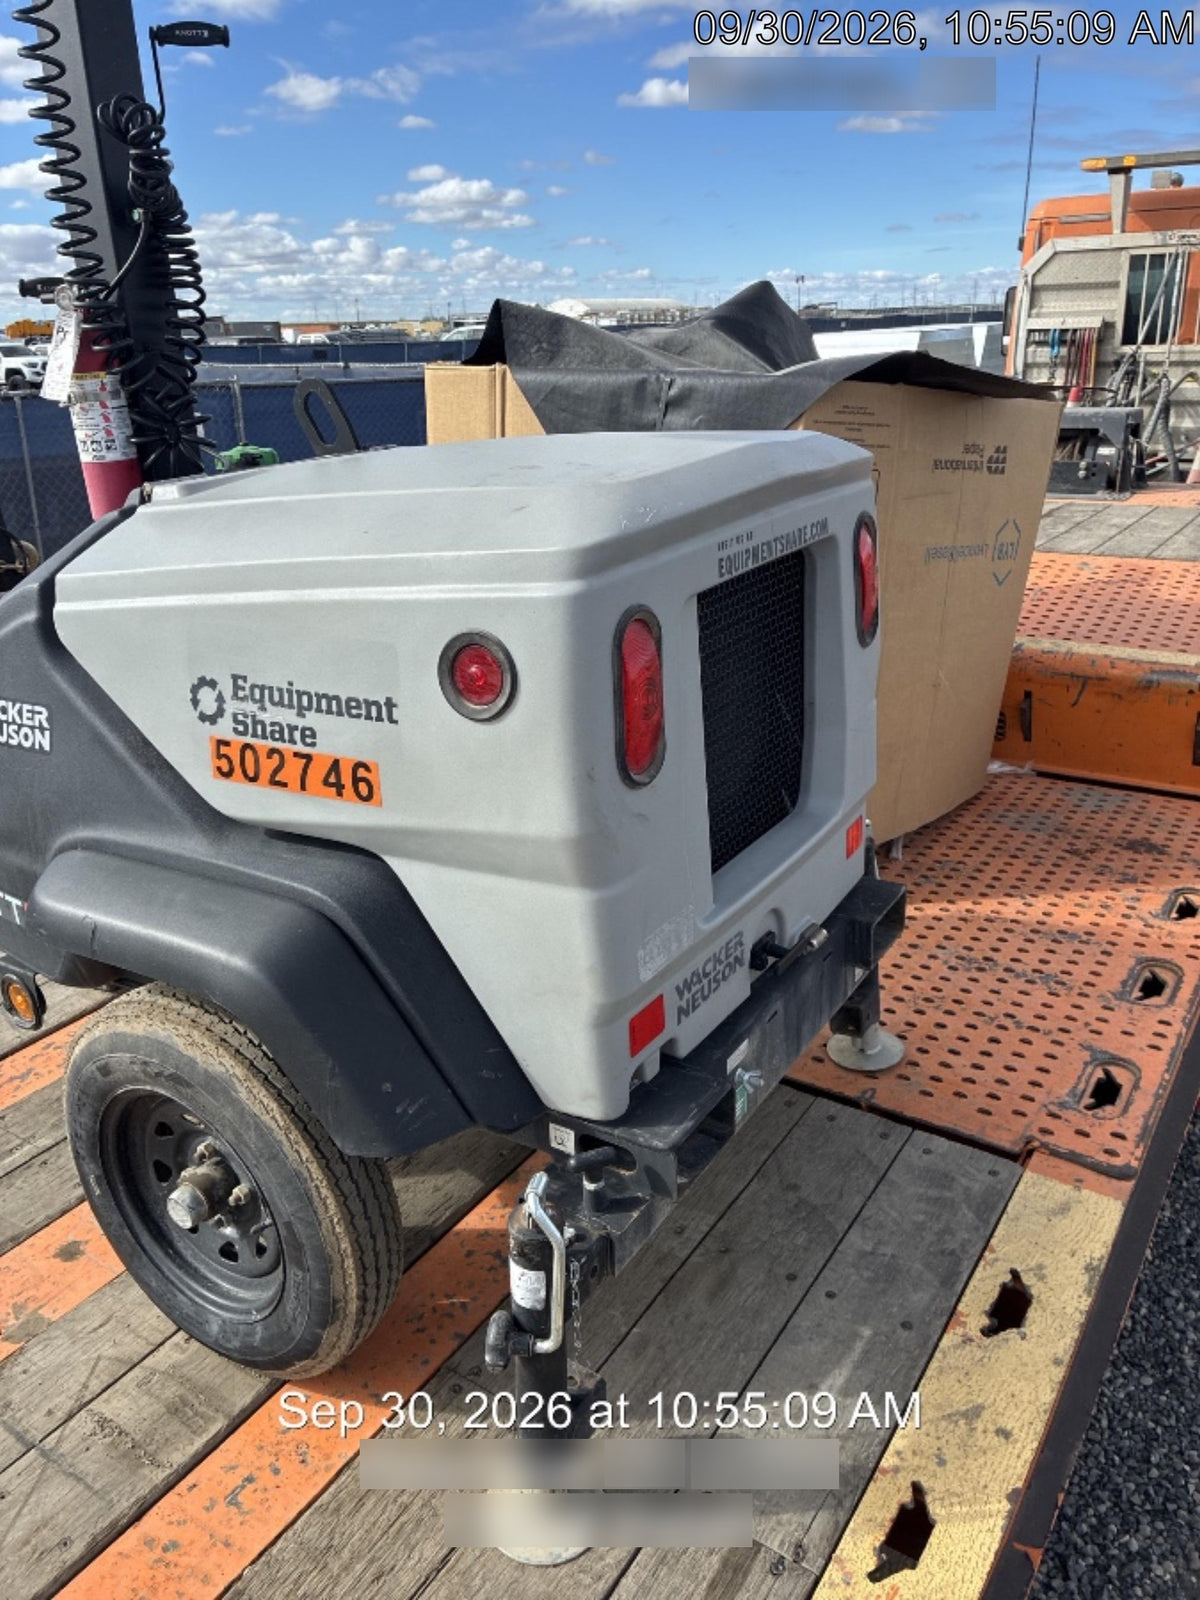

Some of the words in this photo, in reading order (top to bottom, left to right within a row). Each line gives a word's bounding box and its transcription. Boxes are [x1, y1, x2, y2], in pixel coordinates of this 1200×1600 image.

[230, 673, 399, 725] Equipment
[232, 711, 318, 747] Share
[215, 738, 374, 803] 502746
[675, 931, 745, 1001] WACKER
[677, 949, 746, 1026] NEUSON
